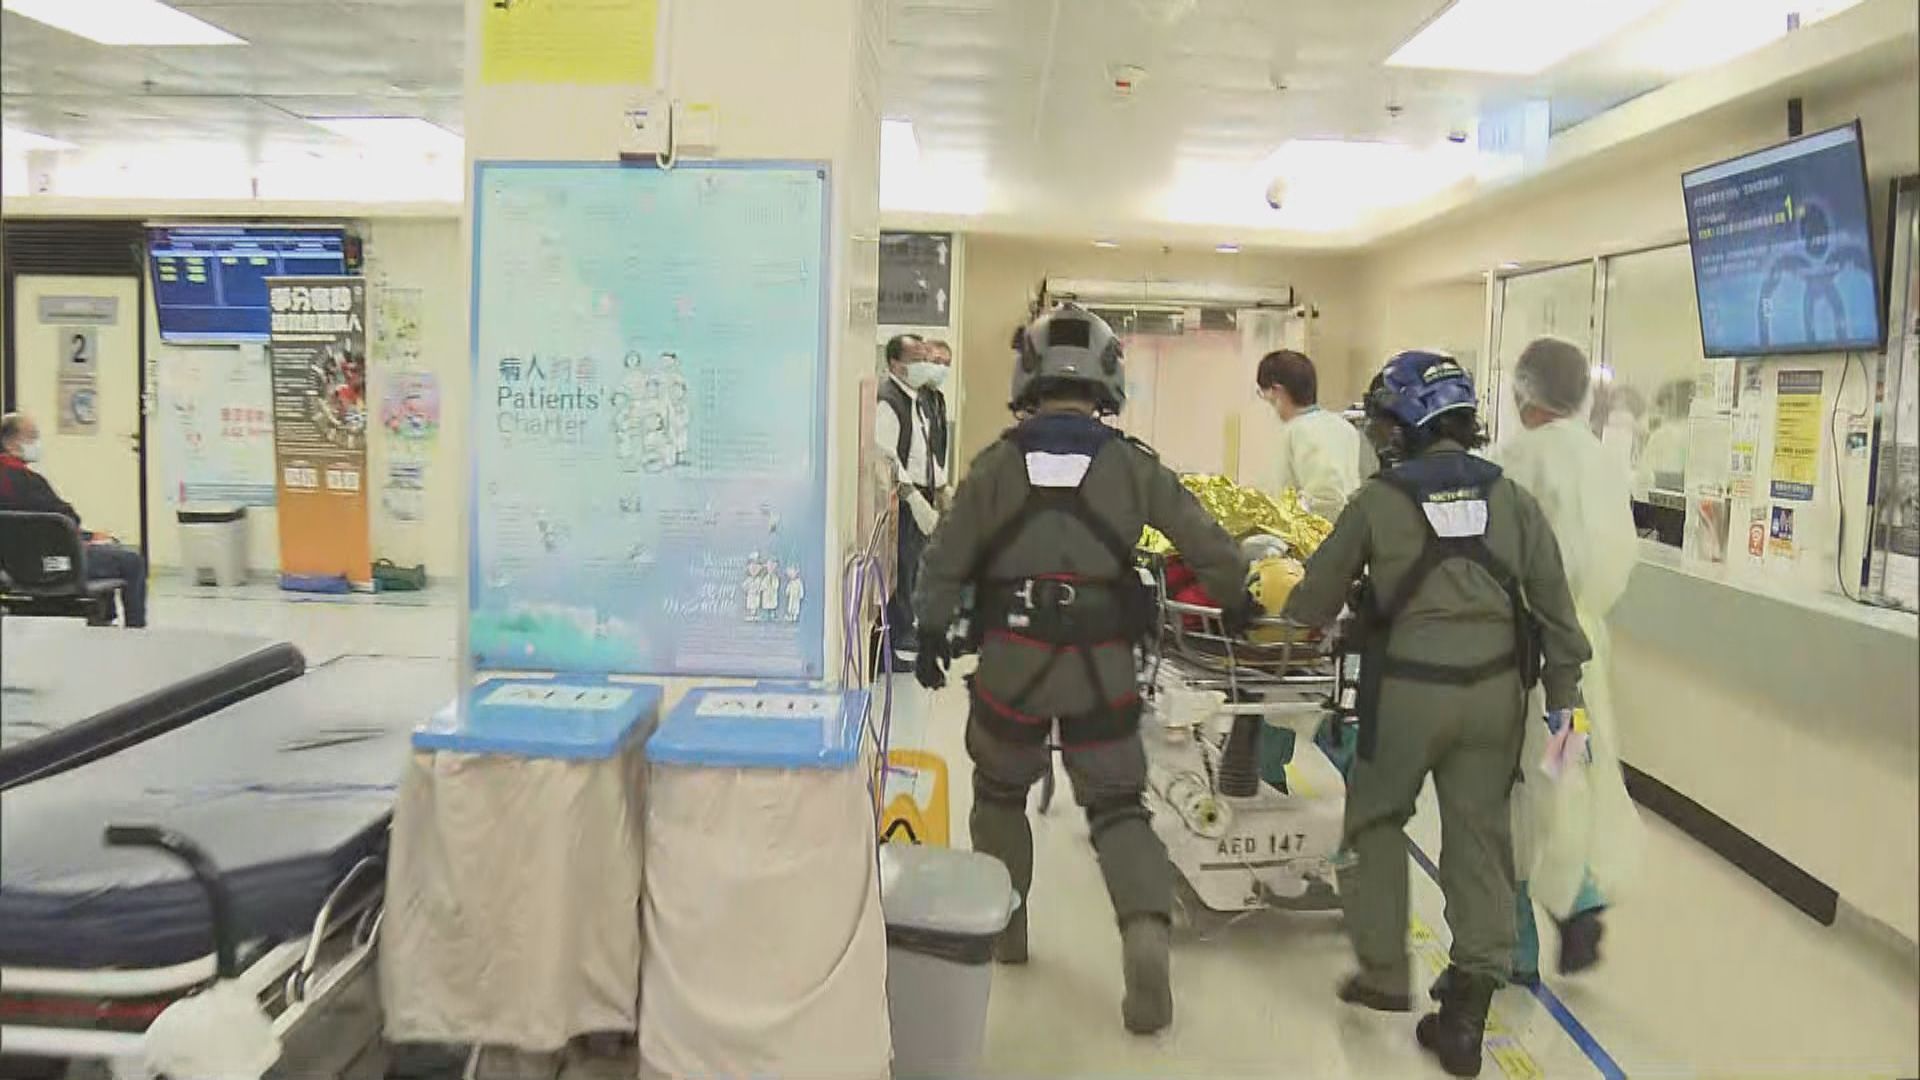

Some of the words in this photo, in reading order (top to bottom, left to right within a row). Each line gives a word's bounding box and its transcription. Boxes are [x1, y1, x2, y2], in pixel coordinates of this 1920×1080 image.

[71, 334, 87, 363] 2
[497, 386, 604, 410] Patients'
[497, 412, 588, 435] Charter
[1217, 838, 1256, 855] AED
[1270, 834, 1306, 853] 147
